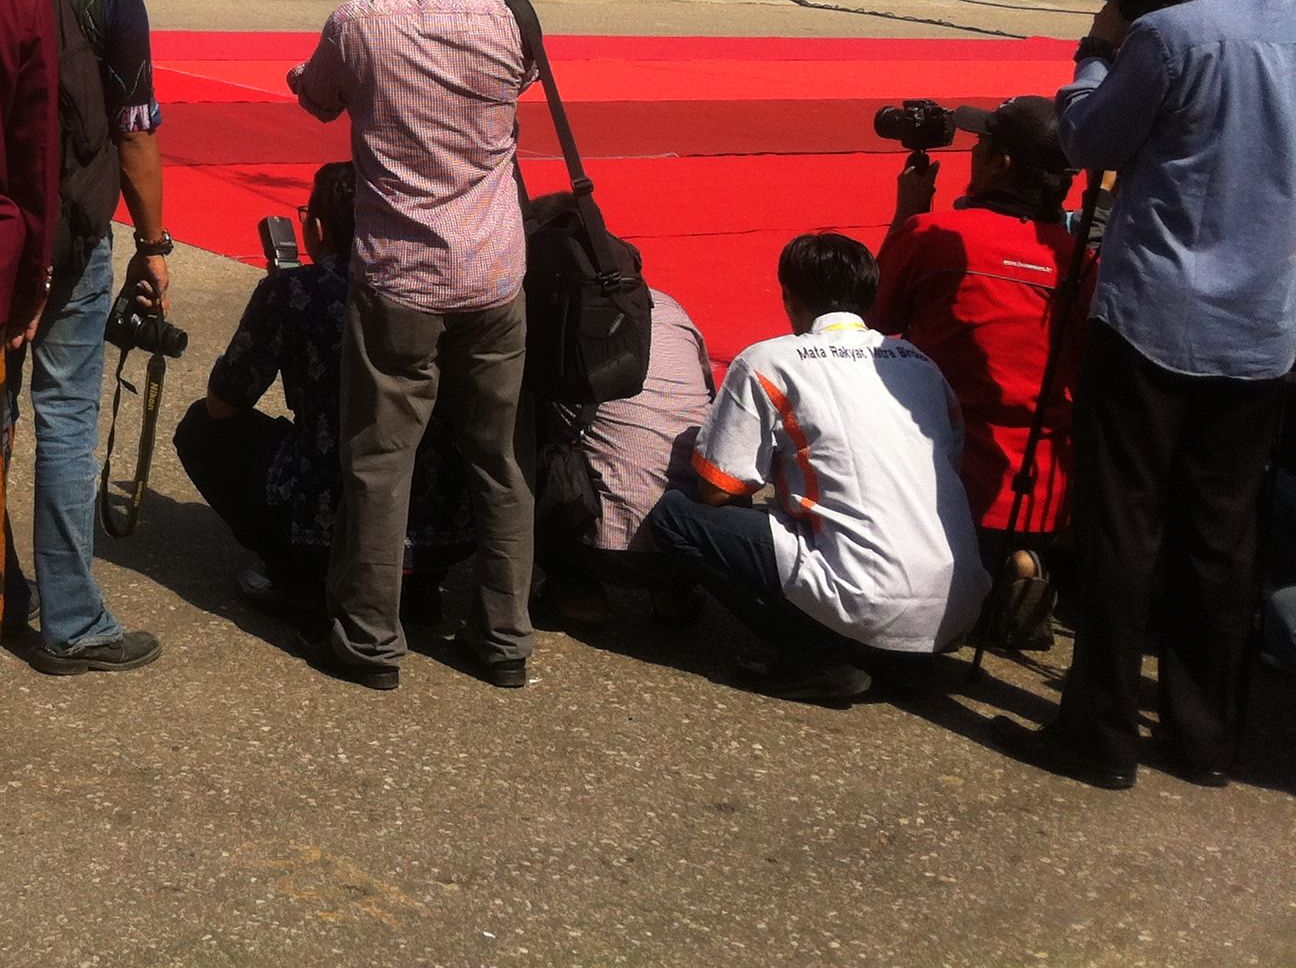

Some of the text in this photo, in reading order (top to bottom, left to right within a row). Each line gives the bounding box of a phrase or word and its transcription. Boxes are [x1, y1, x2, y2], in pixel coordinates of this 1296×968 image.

[796, 346, 826, 361] Mata
[829, 346, 867, 362] Rakyat
[147, 382, 159, 411] Nikon
